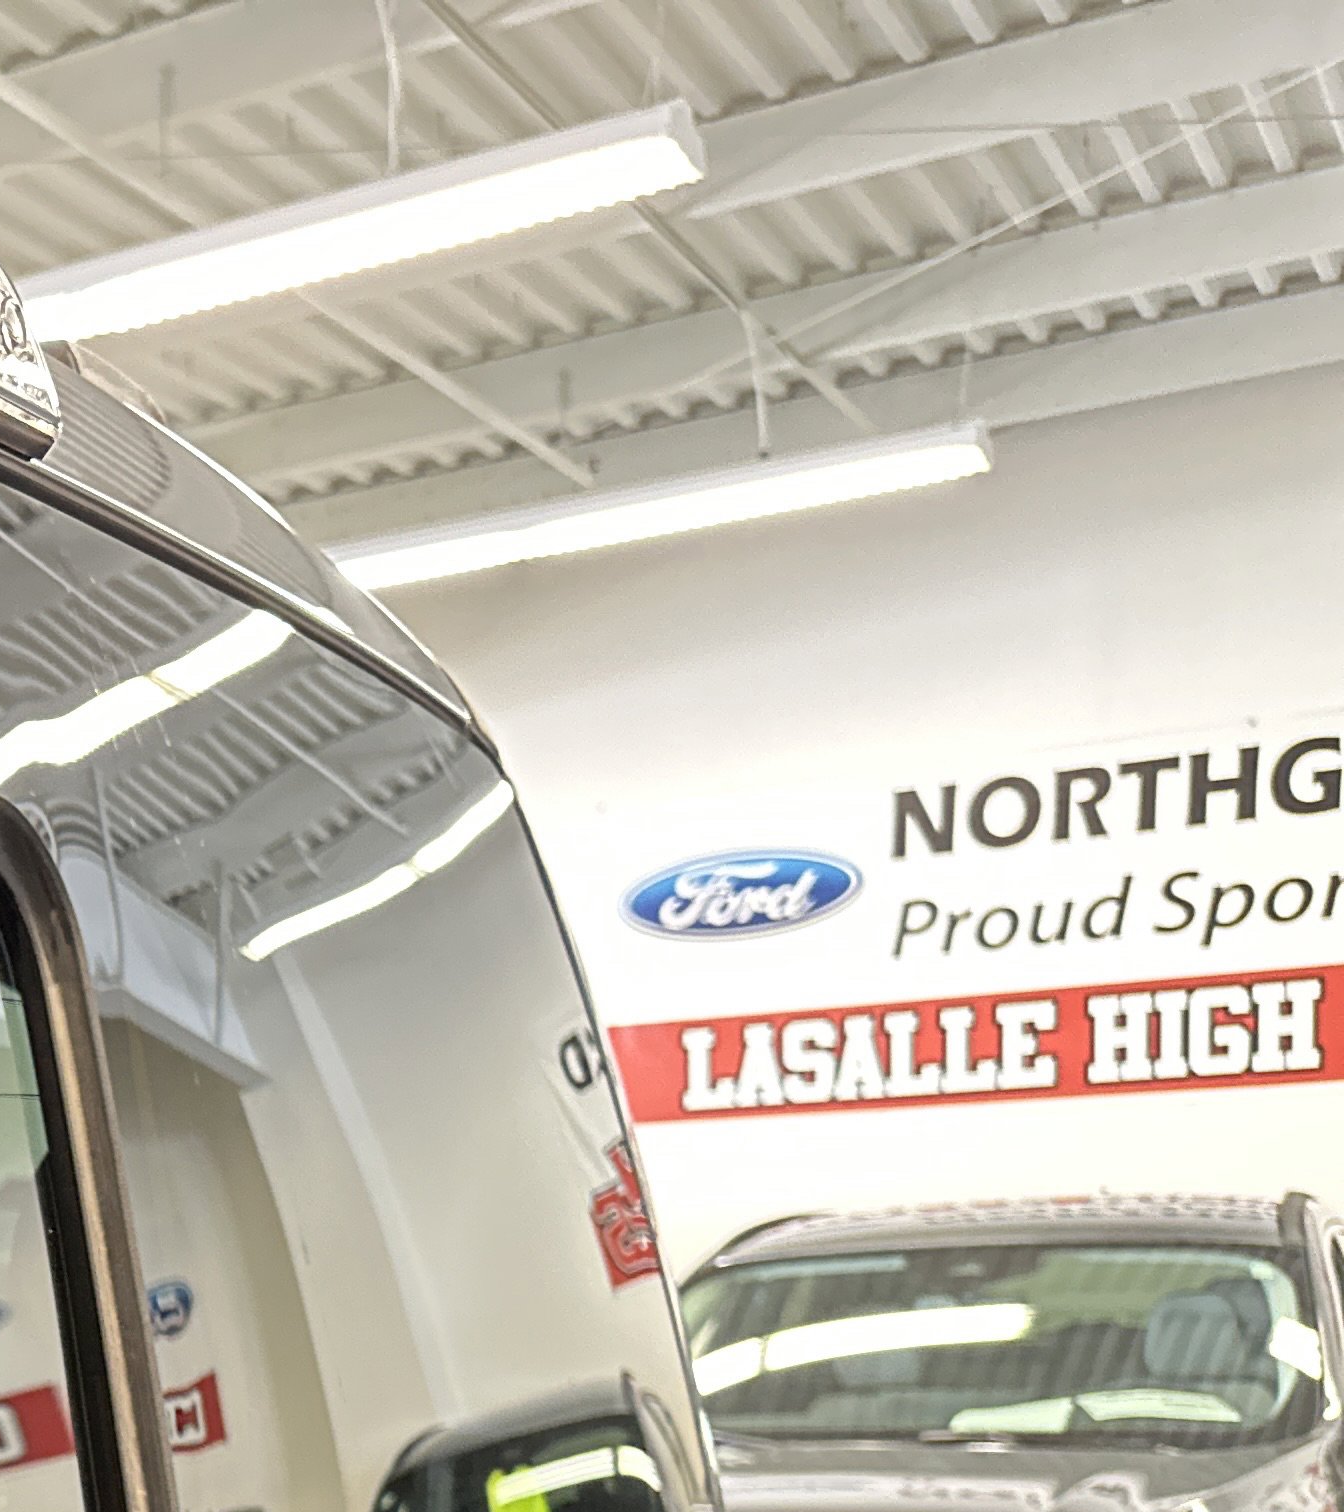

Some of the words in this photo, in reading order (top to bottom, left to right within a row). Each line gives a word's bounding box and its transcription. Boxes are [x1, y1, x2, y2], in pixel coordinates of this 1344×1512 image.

[890, 737, 1343, 858] NORTHG
[658, 860, 817, 930] Ford
[890, 876, 1134, 958] Proud
[679, 998, 1060, 1112] LASALLE
[1084, 977, 1326, 1084] HIGH
